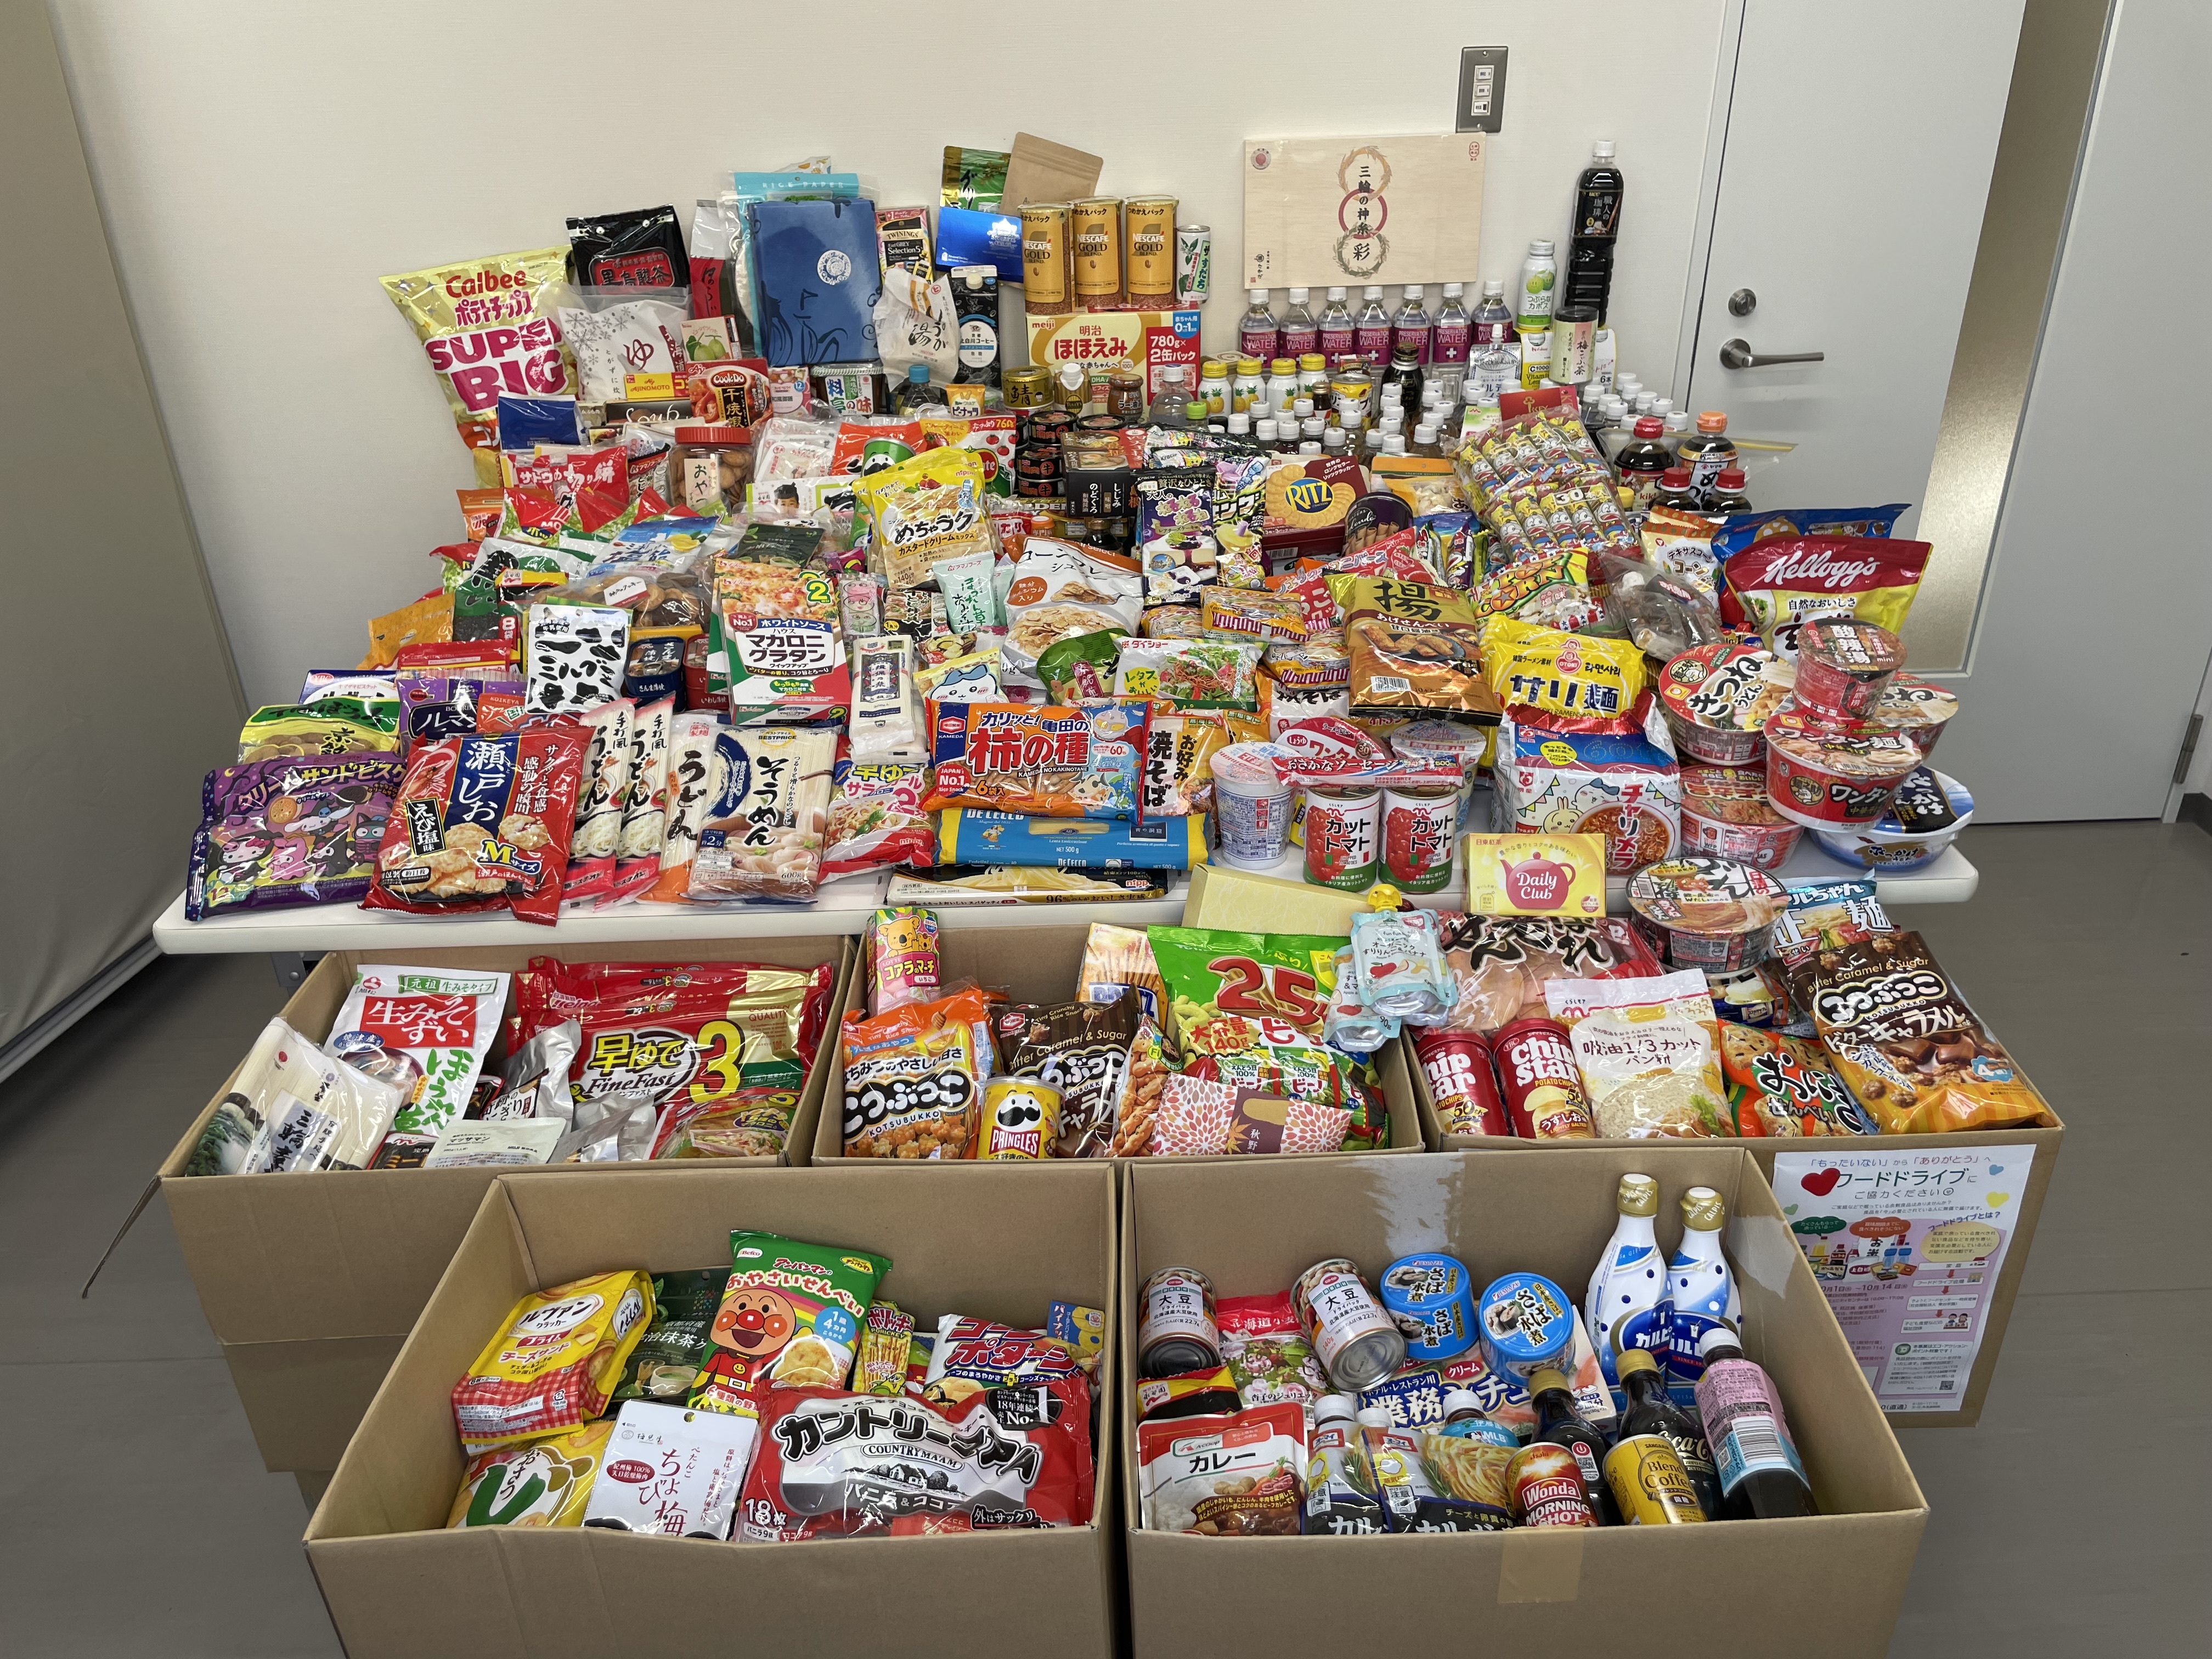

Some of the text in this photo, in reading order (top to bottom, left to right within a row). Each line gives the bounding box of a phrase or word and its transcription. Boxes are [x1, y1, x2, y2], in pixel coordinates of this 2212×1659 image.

[1357, 166, 1371, 236] 三輪の神糸
[886, 230, 920, 240] TWININGS
[1024, 250, 1050, 259] GOLD
[1079, 243, 1108, 252] GOLD
[1134, 243, 1163, 252] GOLD
[1352, 243, 1370, 261] 彩
[445, 270, 527, 297] Calbee
[1032, 320, 1055, 330] meiji
[1080, 325, 1102, 336] 明治
[1246, 334, 1276, 342] PRESERVATION
[1246, 339, 1277, 349] WATER
[1286, 340, 1316, 349] WATER
[1322, 338, 1352, 348] WATER
[1359, 337, 1390, 346] WATER
[1437, 335, 1468, 343] WATER
[624, 339, 654, 370] ゆ
[1054, 338, 1127, 360] ほほえみ
[1150, 350, 1195, 362] 2缶パック
[452, 350, 567, 414] BIG
[631, 383, 670, 393] AJINOMOTO
[1600, 375, 1612, 384] 6本
[1009, 385, 1034, 405] 鯖
[1325, 458, 1341, 467] 世界の
[519, 460, 614, 489] サトウの切り餅
[1089, 483, 1098, 514] のどぐろ
[1113, 483, 1121, 507] しじみ
[1146, 490, 1173, 500] 大人の
[1285, 480, 1334, 511] RITZ
[1155, 493, 1201, 516] ねるねる
[894, 510, 974, 545] めちゃラク
[1764, 550, 1884, 588] Kellogg's
[1373, 580, 1442, 622] 揚
[1788, 597, 1857, 611] 自然なおいしさ
[502, 618, 516, 630] 8
[761, 620, 826, 630] ホワイトソース
[1376, 612, 1450, 629] あげせんべい
[746, 635, 825, 647] マカロニ
[1131, 640, 1169, 648] ダイショー
[749, 648, 826, 663] グラタン
[1125, 669, 1156, 681] レタス
[1584, 662, 1622, 677] 라면사리
[490, 696, 520, 705] KOIKEYA
[1509, 674, 1621, 713] サリ麺
[1733, 684, 1763, 709] うどん
[612, 711, 628, 749] 手打風
[651, 713, 668, 751] 手打風
[1042, 719, 1090, 733] 亀田の
[966, 728, 1090, 775] 柿の種
[1110, 746, 1122, 755] 60
[1172, 734, 1196, 780] お好み
[1358, 745, 1369, 755] 30
[1144, 730, 1173, 806] 焼そば
[1287, 759, 1399, 771] おさかなソーセージ
[939, 775, 967, 786] No.1
[666, 749, 707, 842] うどん
[743, 756, 788, 847] そうめん
[414, 802, 439, 853] えび塩味
[1326, 818, 1372, 834] カット
[1412, 814, 1454, 834] カット
[1325, 837, 1371, 851] トマト
[1410, 835, 1453, 851] トマト
[481, 840, 514, 864] M
[1516, 871, 1557, 890] Daily
[1520, 886, 1552, 900] Club
[882, 957, 902, 966] LOTTE
[1835, 963, 1884, 981] Caramel
[1897, 957, 1929, 970] Sugar
[883, 961, 934, 980] コアラのマーチ
[410, 978, 437, 990] 元祖
[441, 980, 494, 994] 生みそタイプ
[366, 996, 471, 1026] 生みそ
[748, 1012, 787, 1022] QUALITY
[1865, 999, 1927, 1022] KOTSUBUKKO
[1190, 1017, 1250, 1045] 大容量
[1207, 1035, 1249, 1053] 140g
[1511, 1036, 1572, 1068] chip
[589, 1032, 686, 1075] 早ゆで
[690, 1020, 744, 1103] 3
[869, 1110, 940, 1137] KOTSUBUKKO
[992, 1132, 1039, 1154] PRINGLES
[1837, 1168, 1978, 1188] フードドライブに
[1855, 1189, 1939, 1199] ご協力ください
[726, 1269, 865, 1318] おやさいせんべい
[1159, 1293, 1192, 1307] 大豆
[1325, 1288, 1359, 1311] 大豆
[521, 1300, 593, 1326] ルヴァン
[1154, 1309, 1198, 1319] 北海道産大豆使用
[1329, 1304, 1370, 1326] 北海道産大豆使用
[537, 1319, 567, 1329] クラッカー
[1447, 1363, 1480, 1378] クリーム
[1189, 1452, 1256, 1474] カレー
[1647, 1462, 1683, 1475] Blend
[1526, 1482, 1576, 1506] Wonda
[974, 1508, 1034, 1523] 外はサックリ
[1526, 1501, 1590, 1525] MORNING
